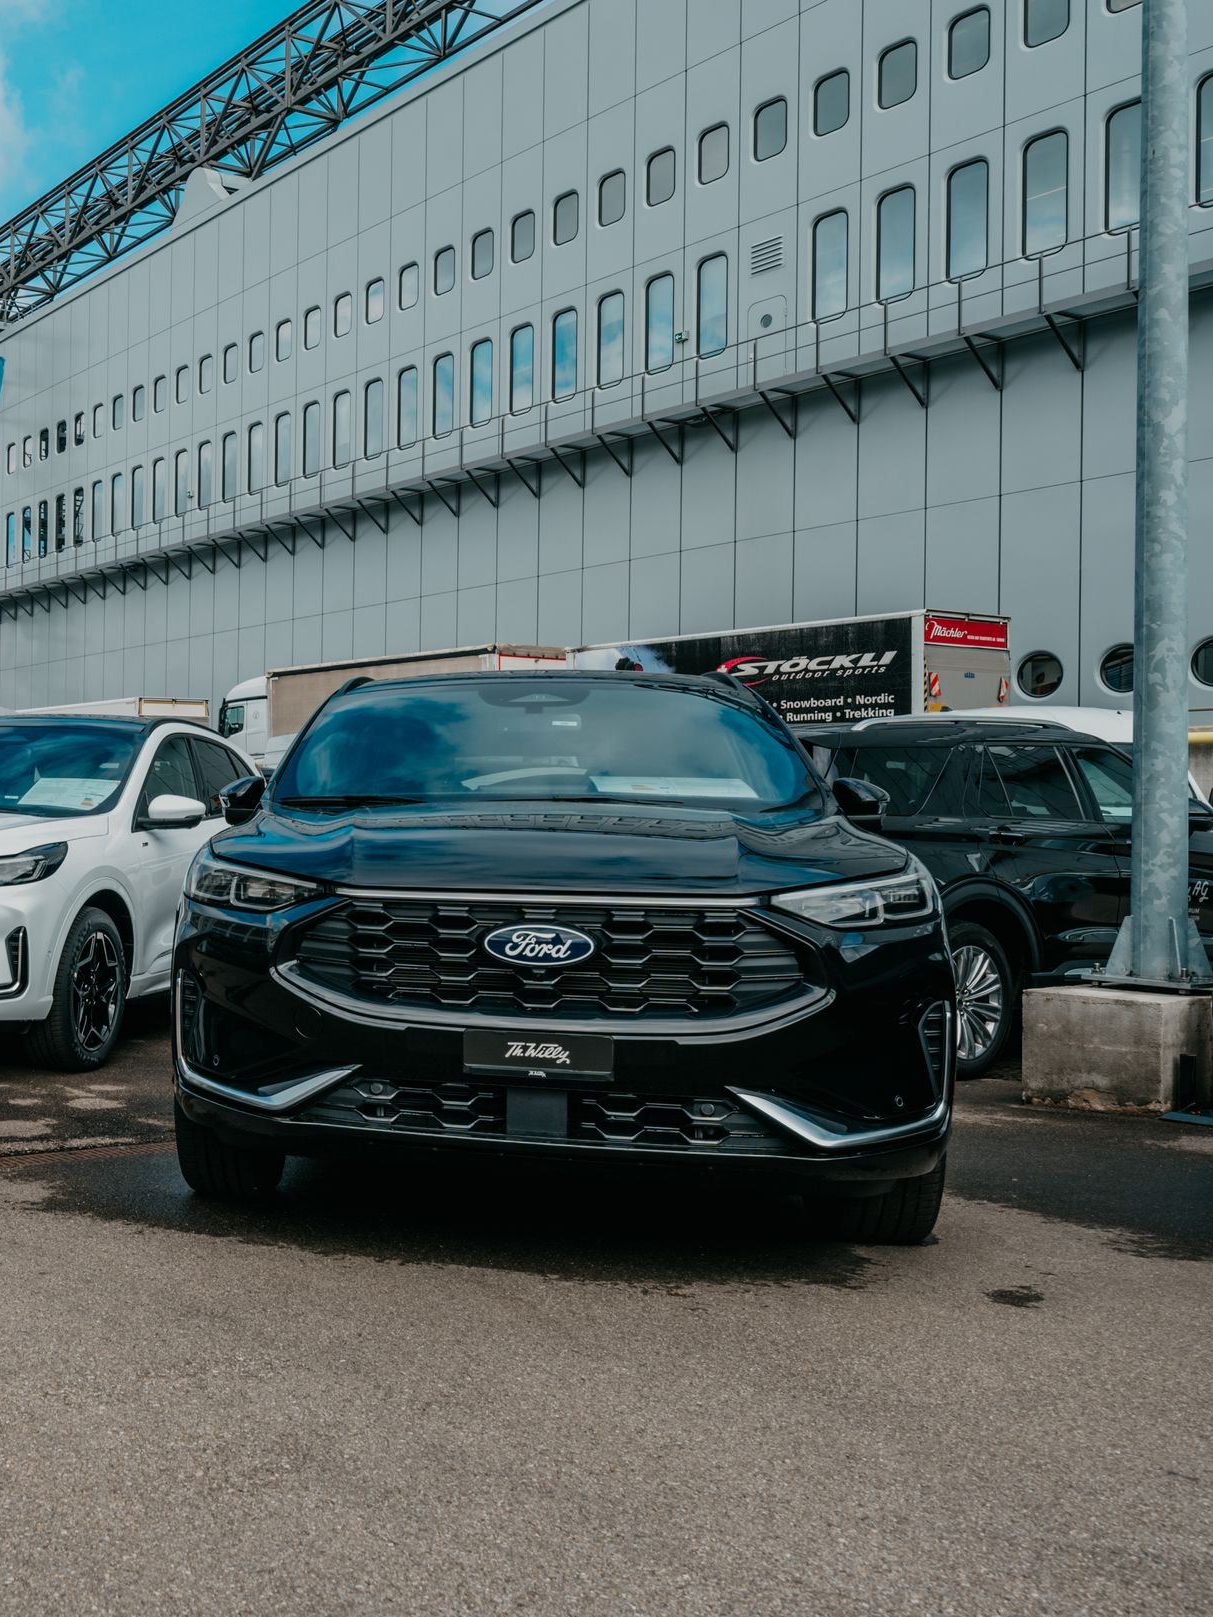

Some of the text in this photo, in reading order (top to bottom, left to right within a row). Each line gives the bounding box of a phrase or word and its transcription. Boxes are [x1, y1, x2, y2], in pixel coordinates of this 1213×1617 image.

[925, 620, 968, 640] Mächler
[730, 650, 898, 677] STÖCKLI
[772, 665, 887, 681] outdoor sports
[780, 693, 895, 709] Snowboard Nordic
[786, 707, 895, 722] Running Trekking
[1192, 880, 1210, 903] AG
[504, 931, 573, 958] Ford
